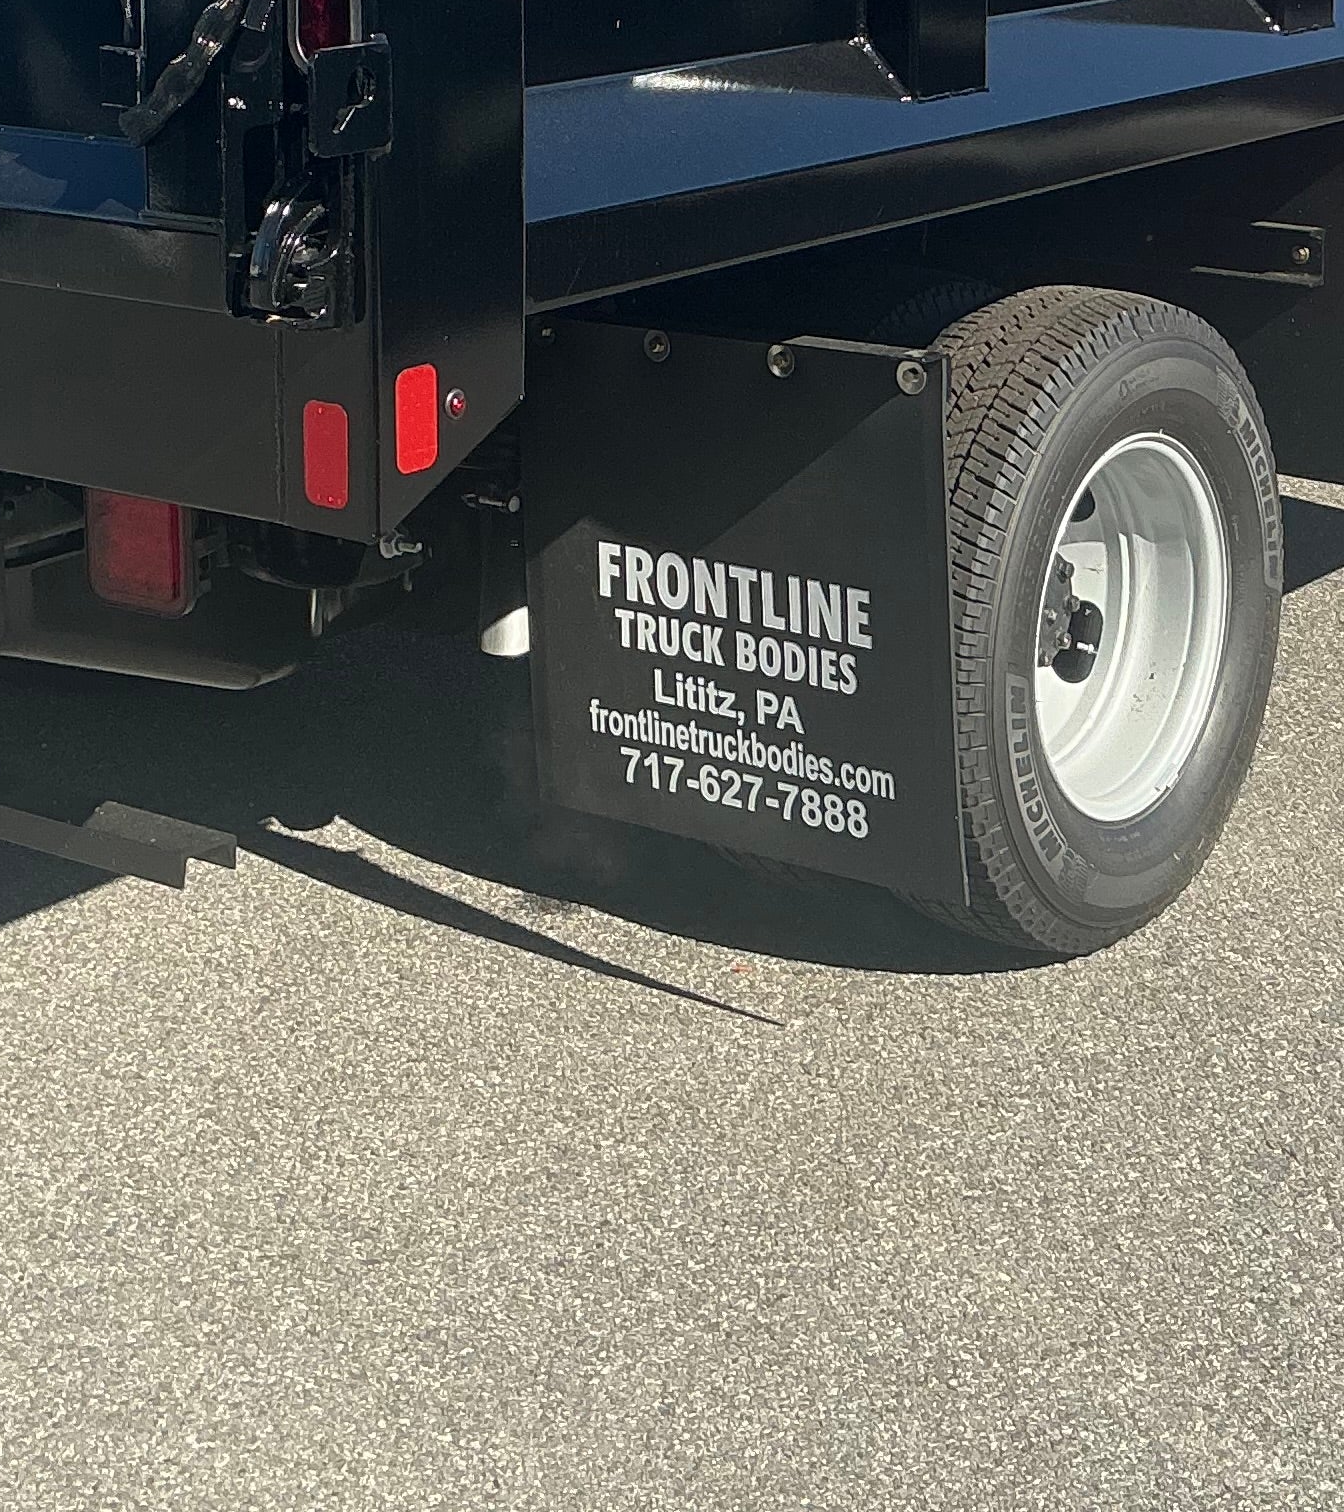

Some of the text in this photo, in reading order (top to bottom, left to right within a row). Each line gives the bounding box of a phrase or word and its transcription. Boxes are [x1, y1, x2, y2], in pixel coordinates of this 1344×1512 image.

[598, 541, 873, 649] FRONTLINE
[615, 608, 858, 695] TRUCK BODIES
[654, 668, 805, 734] Lititz, PA
[589, 699, 895, 800] frontlinetruckbodies.com
[620, 746, 869, 838] 717-627-7888
[1010, 686, 1063, 863] MICHELIN
